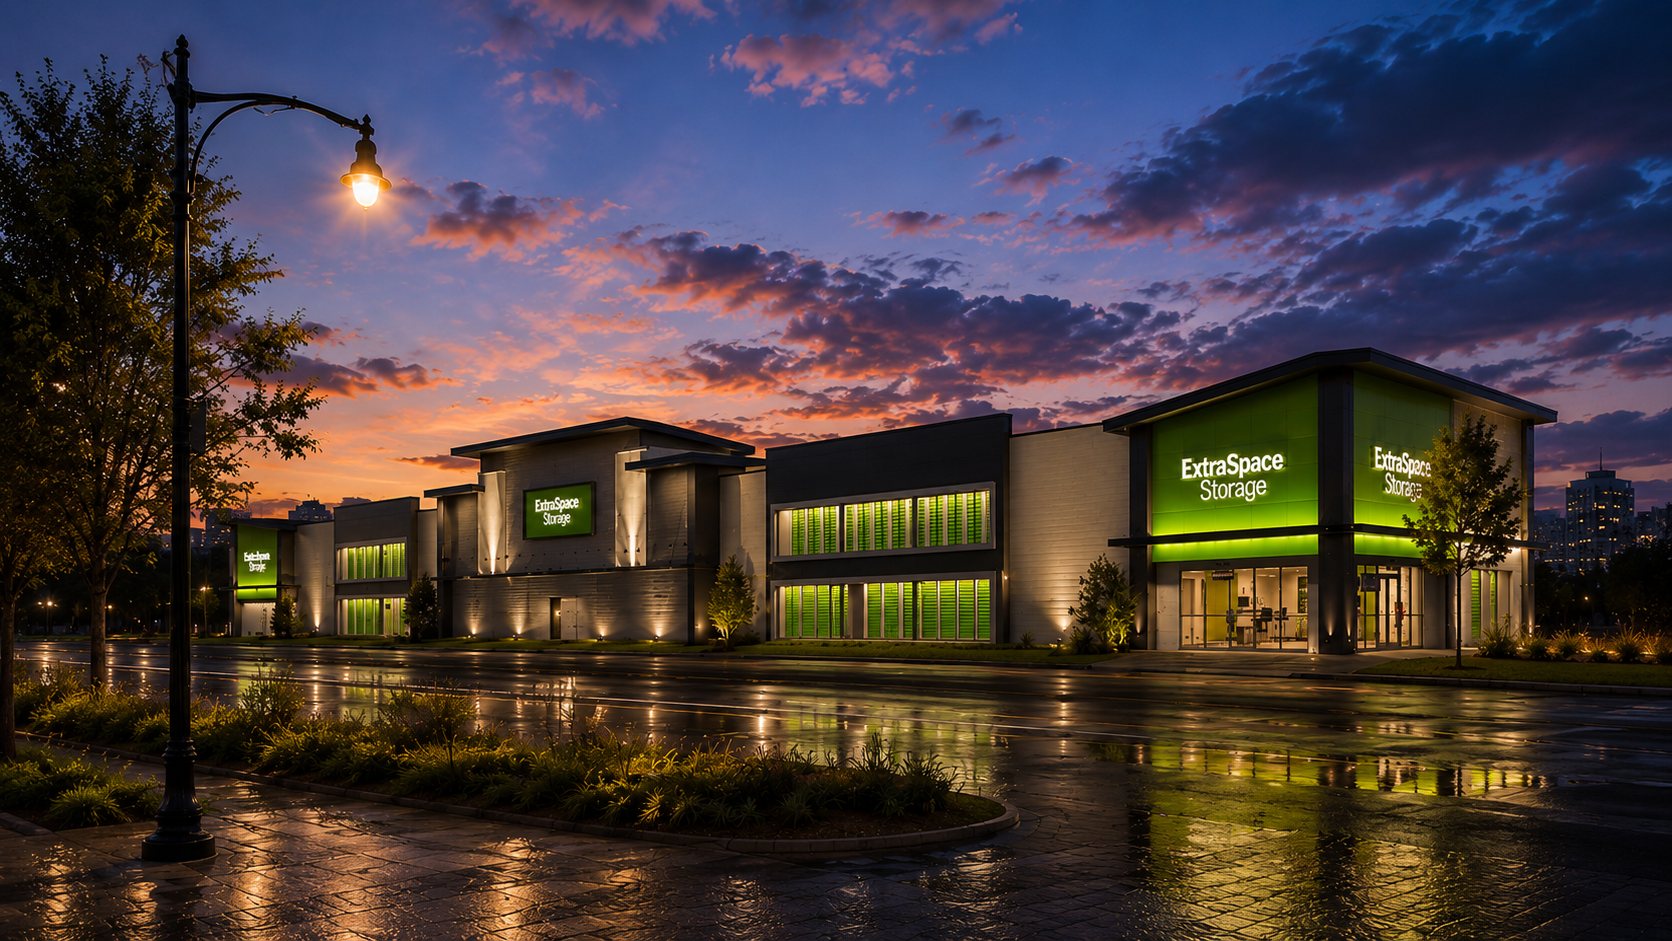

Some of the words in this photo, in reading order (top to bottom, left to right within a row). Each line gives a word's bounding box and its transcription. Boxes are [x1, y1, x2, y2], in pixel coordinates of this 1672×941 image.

[1181, 453, 1284, 480] ExtraSpace
[1200, 479, 1267, 502] Storage
[535, 496, 579, 513] ExtraSpace
[543, 512, 571, 527] Storage
